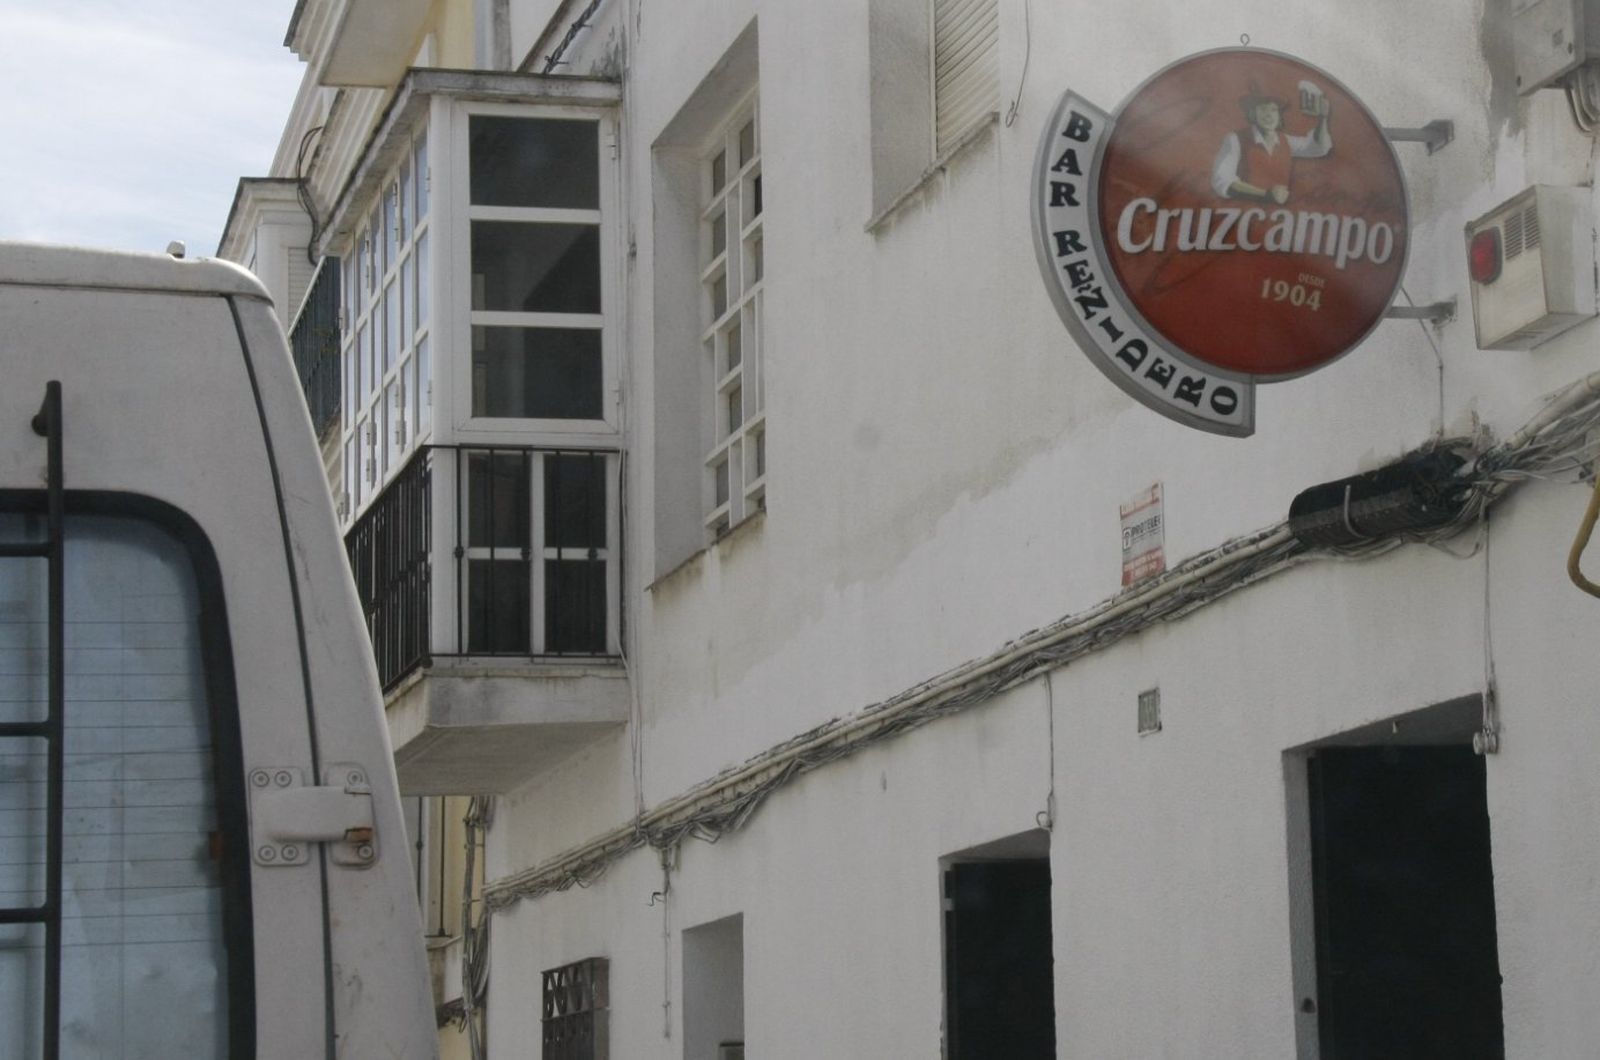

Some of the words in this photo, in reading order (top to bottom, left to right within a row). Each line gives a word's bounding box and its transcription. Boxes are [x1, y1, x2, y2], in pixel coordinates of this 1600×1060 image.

[1048, 110, 1092, 208] BAR
[1117, 197, 1394, 269] Cruzcampo
[1053, 229, 1239, 415] REÑIDERO
[1260, 278, 1322, 312] 1904
